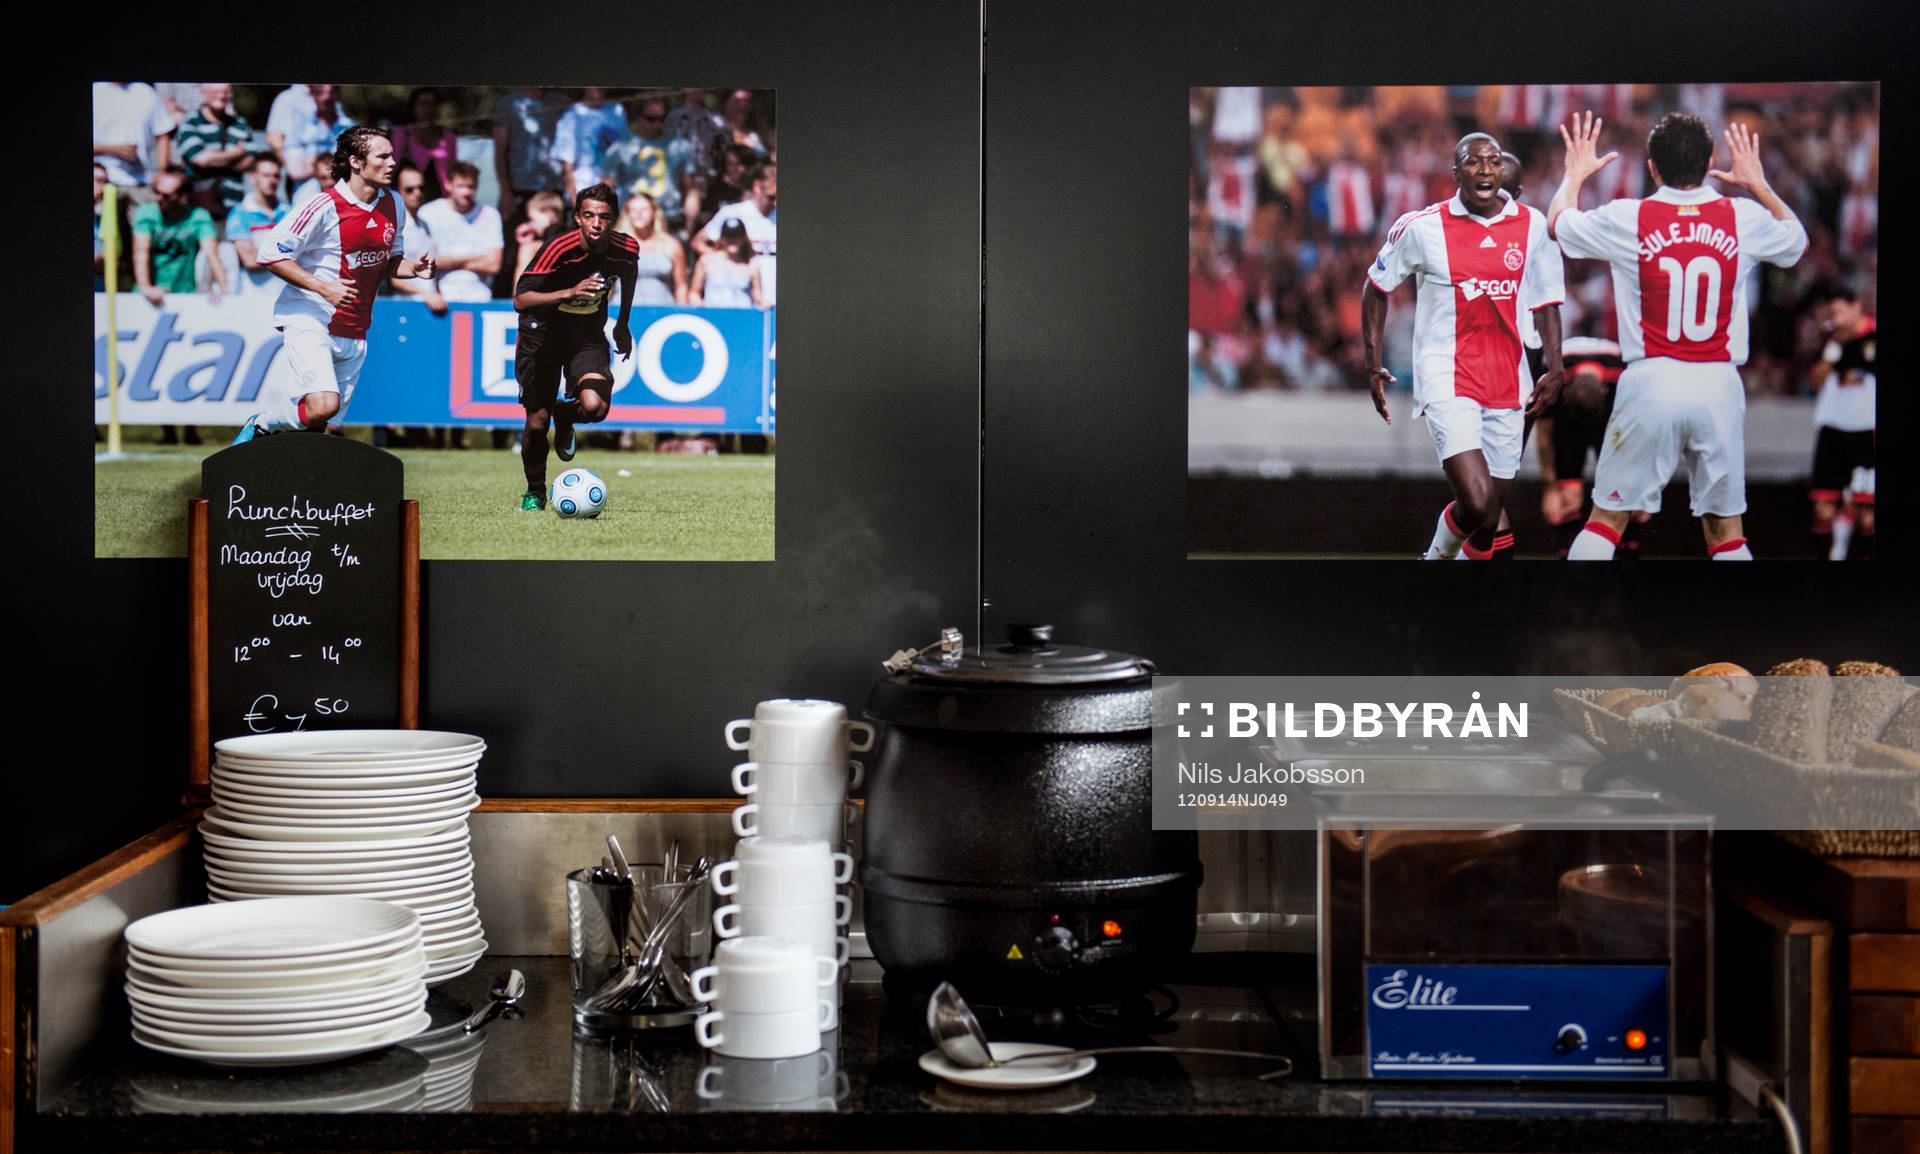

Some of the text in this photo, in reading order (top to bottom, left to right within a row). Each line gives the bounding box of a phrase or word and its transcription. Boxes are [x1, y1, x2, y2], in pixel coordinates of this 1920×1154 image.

[1637, 222, 1739, 262] SULEJMANI
[1658, 255, 1722, 343] 10
[221, 543, 361, 571] Maandag t/m
[272, 613, 312, 627] van
[1372, 969, 1457, 1009] Elite
